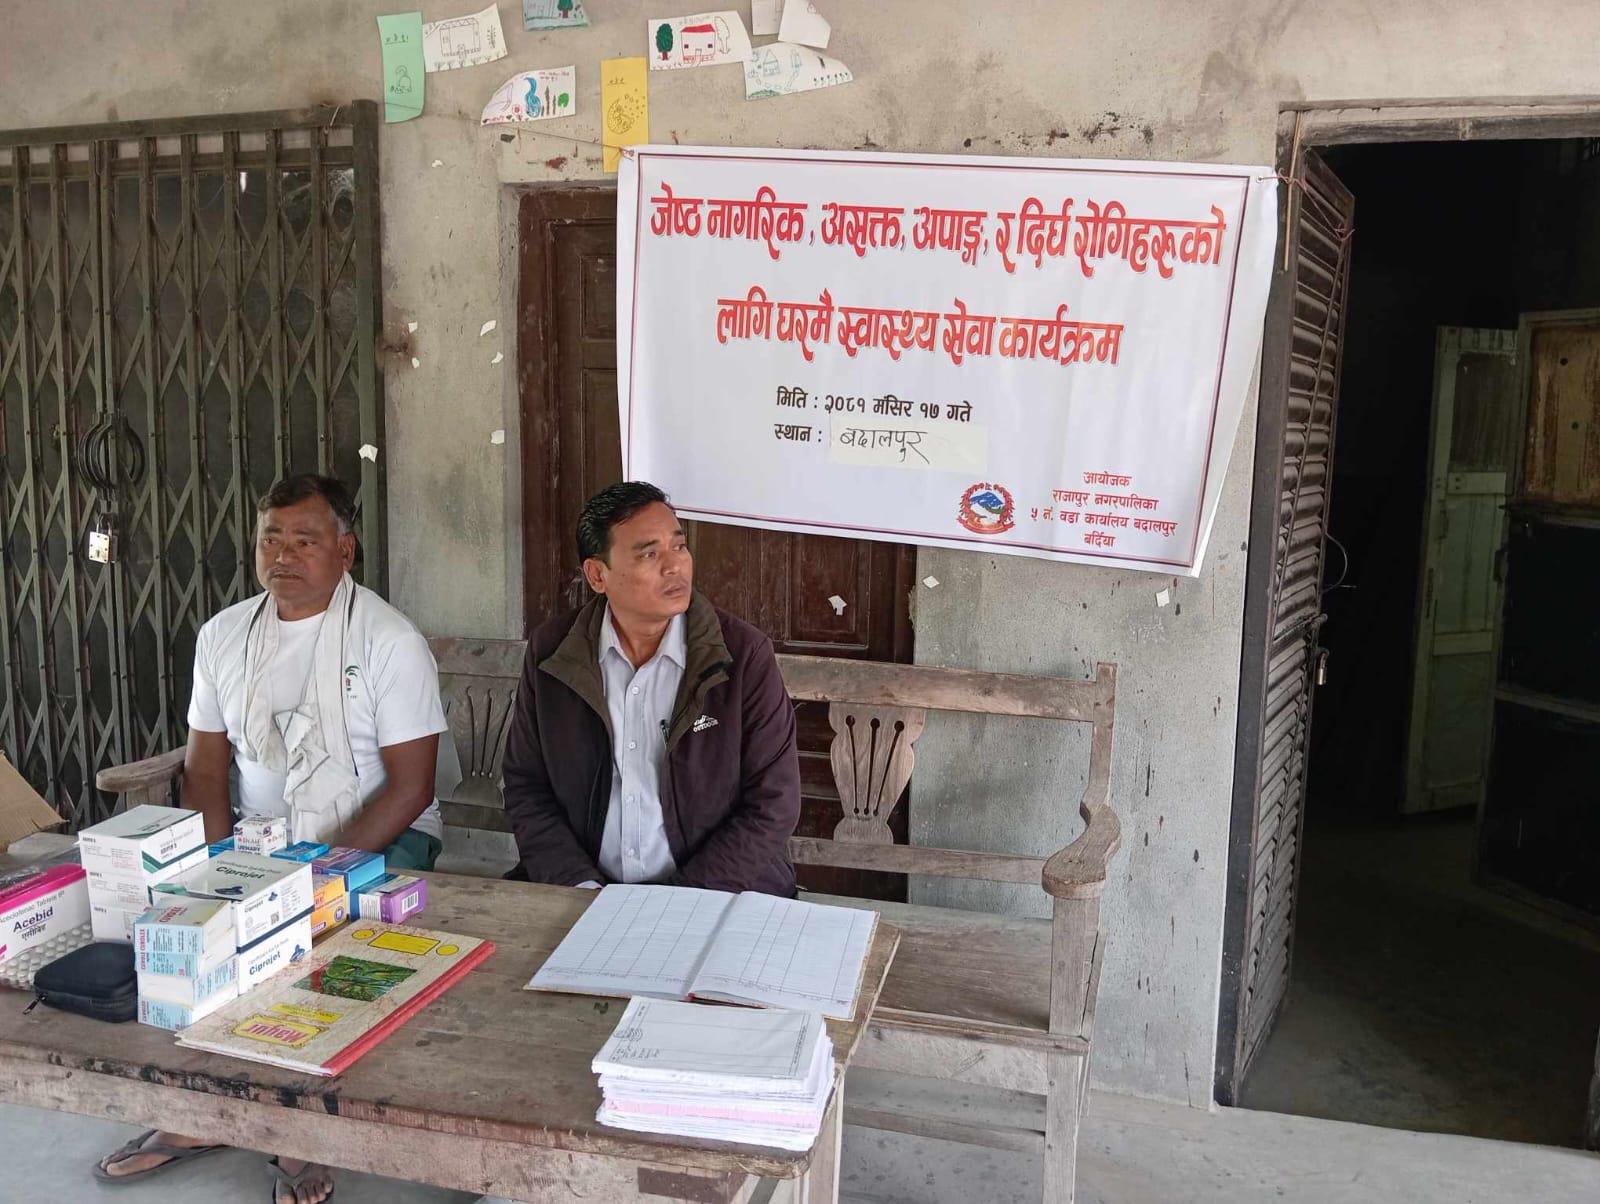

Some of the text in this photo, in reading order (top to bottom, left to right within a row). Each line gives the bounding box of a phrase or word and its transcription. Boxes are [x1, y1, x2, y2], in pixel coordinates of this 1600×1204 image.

[650, 181, 704, 237] जेष्ठ
[996, 211, 1016, 274] र
[1016, 197, 1074, 269] दिर्घ
[717, 285, 1125, 366] लागि घरमै स्वास्थ्य सेवा कार्यक्रम
[776, 385, 809, 409] मिति
[824, 393, 866, 415] २०८१
[872, 393, 915, 418] मंसिर
[919, 402, 940, 420] १७
[945, 400, 973, 423] गते
[774, 423, 812, 443] स्थान
[1083, 471, 1132, 488] आयोजक
[1052, 489, 1159, 511] राजापुर नगरपालिका
[1059, 510, 1081, 525] वडा
[1084, 512, 1130, 529] कार्यालय
[13, 906, 54, 933] Acebid
[248, 951, 281, 976] Ciprojet
